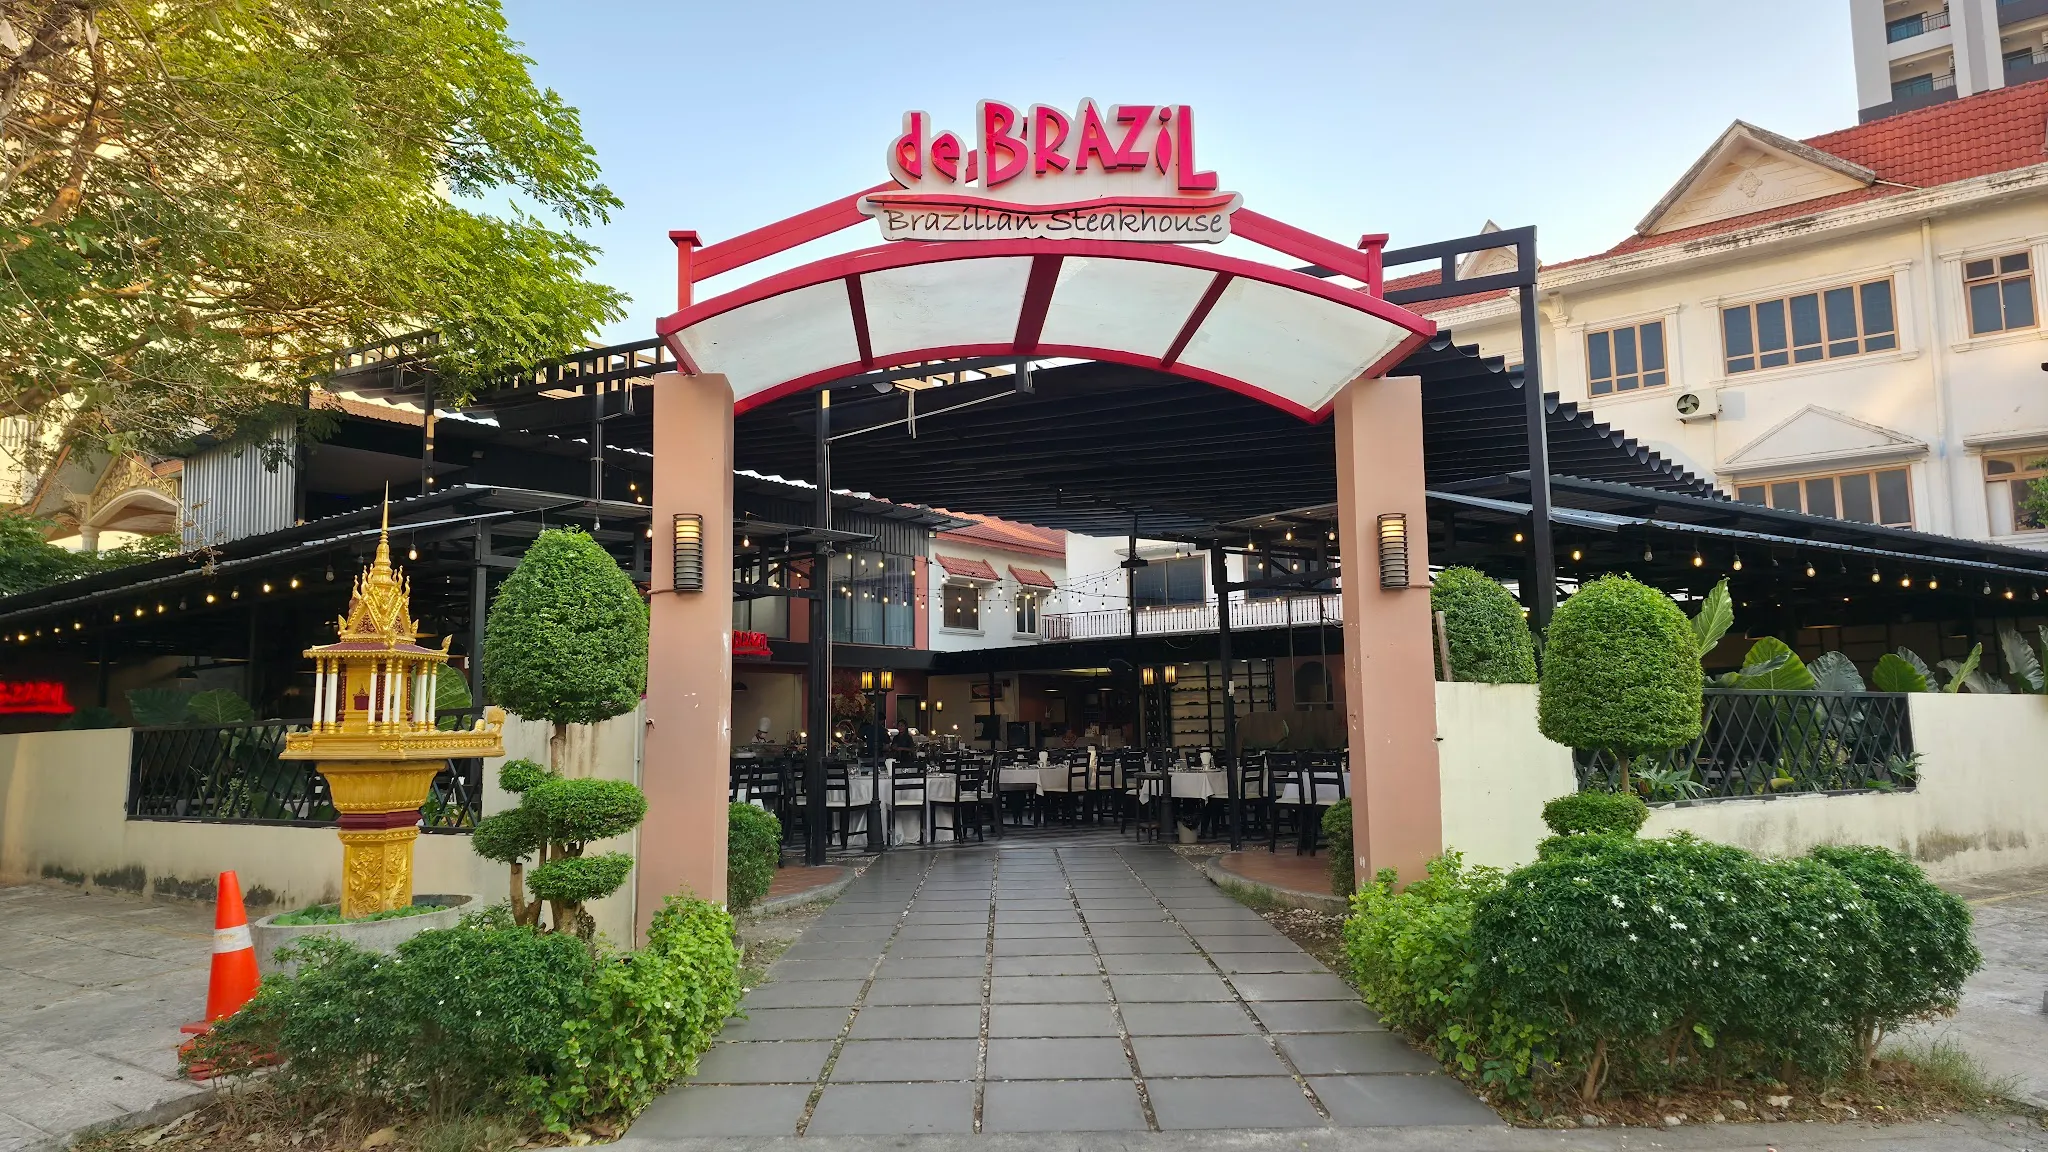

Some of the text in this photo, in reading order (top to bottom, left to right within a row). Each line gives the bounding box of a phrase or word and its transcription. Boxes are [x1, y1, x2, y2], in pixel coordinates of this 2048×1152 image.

[895, 111, 960, 183] de
[884, 205, 1224, 234] Brazilian Steakhouse
